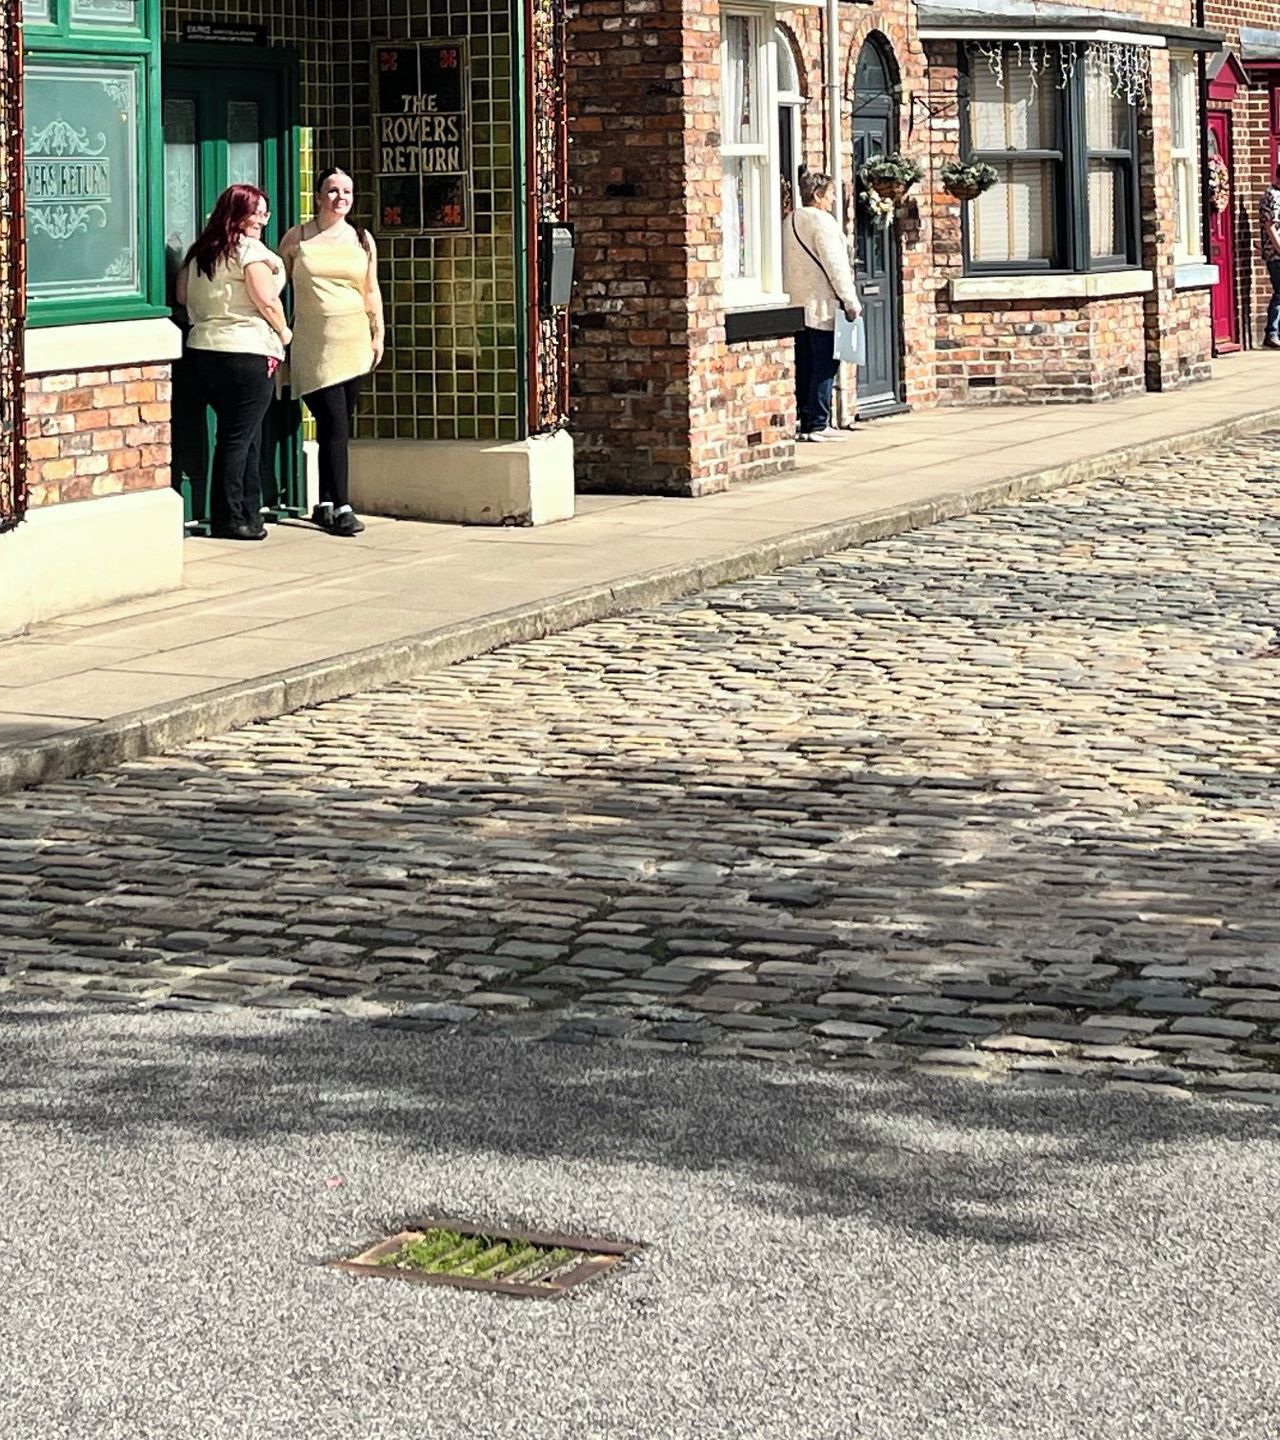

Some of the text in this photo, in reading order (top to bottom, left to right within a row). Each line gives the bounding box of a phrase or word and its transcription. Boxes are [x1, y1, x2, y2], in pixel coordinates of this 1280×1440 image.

[401, 94, 438, 114] THE
[381, 115, 459, 143] ROVERS
[382, 145, 460, 173] RETURN
[26, 165, 108, 196] VERS RETURN
